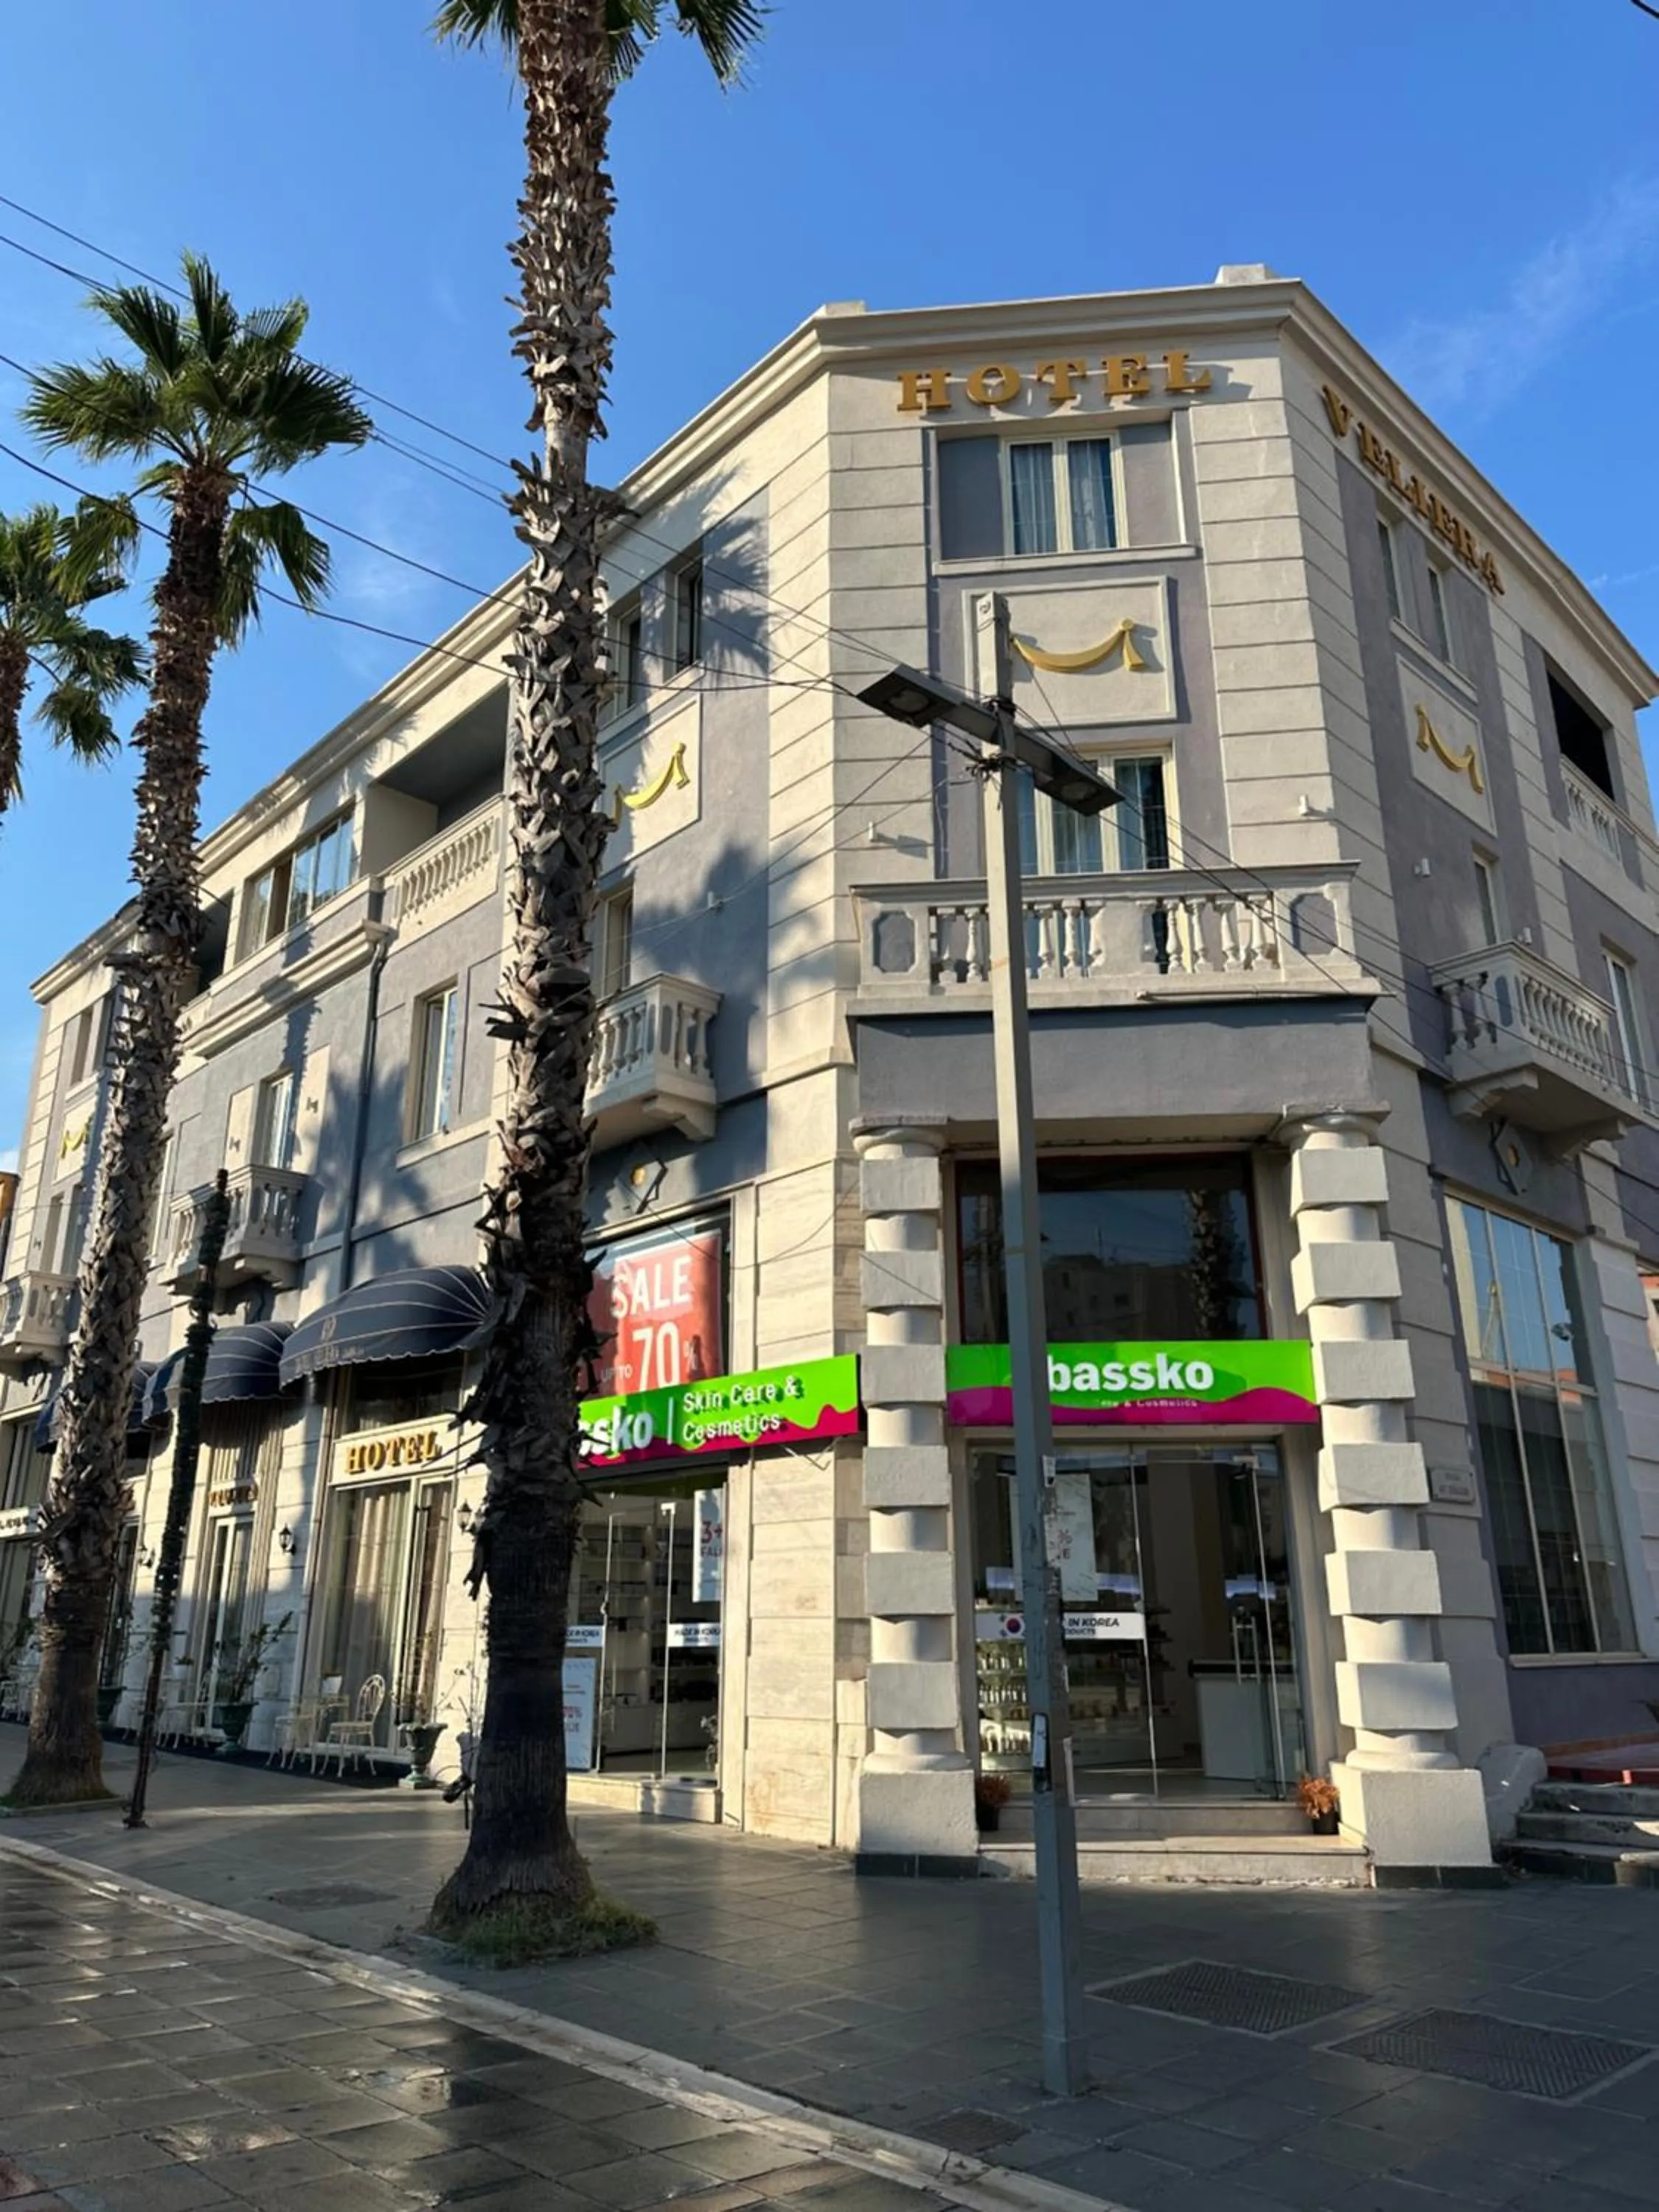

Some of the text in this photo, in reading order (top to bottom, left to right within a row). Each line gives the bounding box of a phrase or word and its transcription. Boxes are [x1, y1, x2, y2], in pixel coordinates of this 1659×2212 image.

[897, 350, 1214, 411] HOTEL
[1322, 385, 1505, 596] VELIERA
[611, 1254, 692, 1319] SALE
[684, 1375, 799, 1413] Skin Care &
[1047, 1352, 1214, 1391] bassko
[578, 1405, 653, 1456] ssko
[683, 1413, 781, 1443] Cosmetics
[347, 1430, 442, 1475] HOTEL
[1082, 1617, 1120, 1627] KOREA
